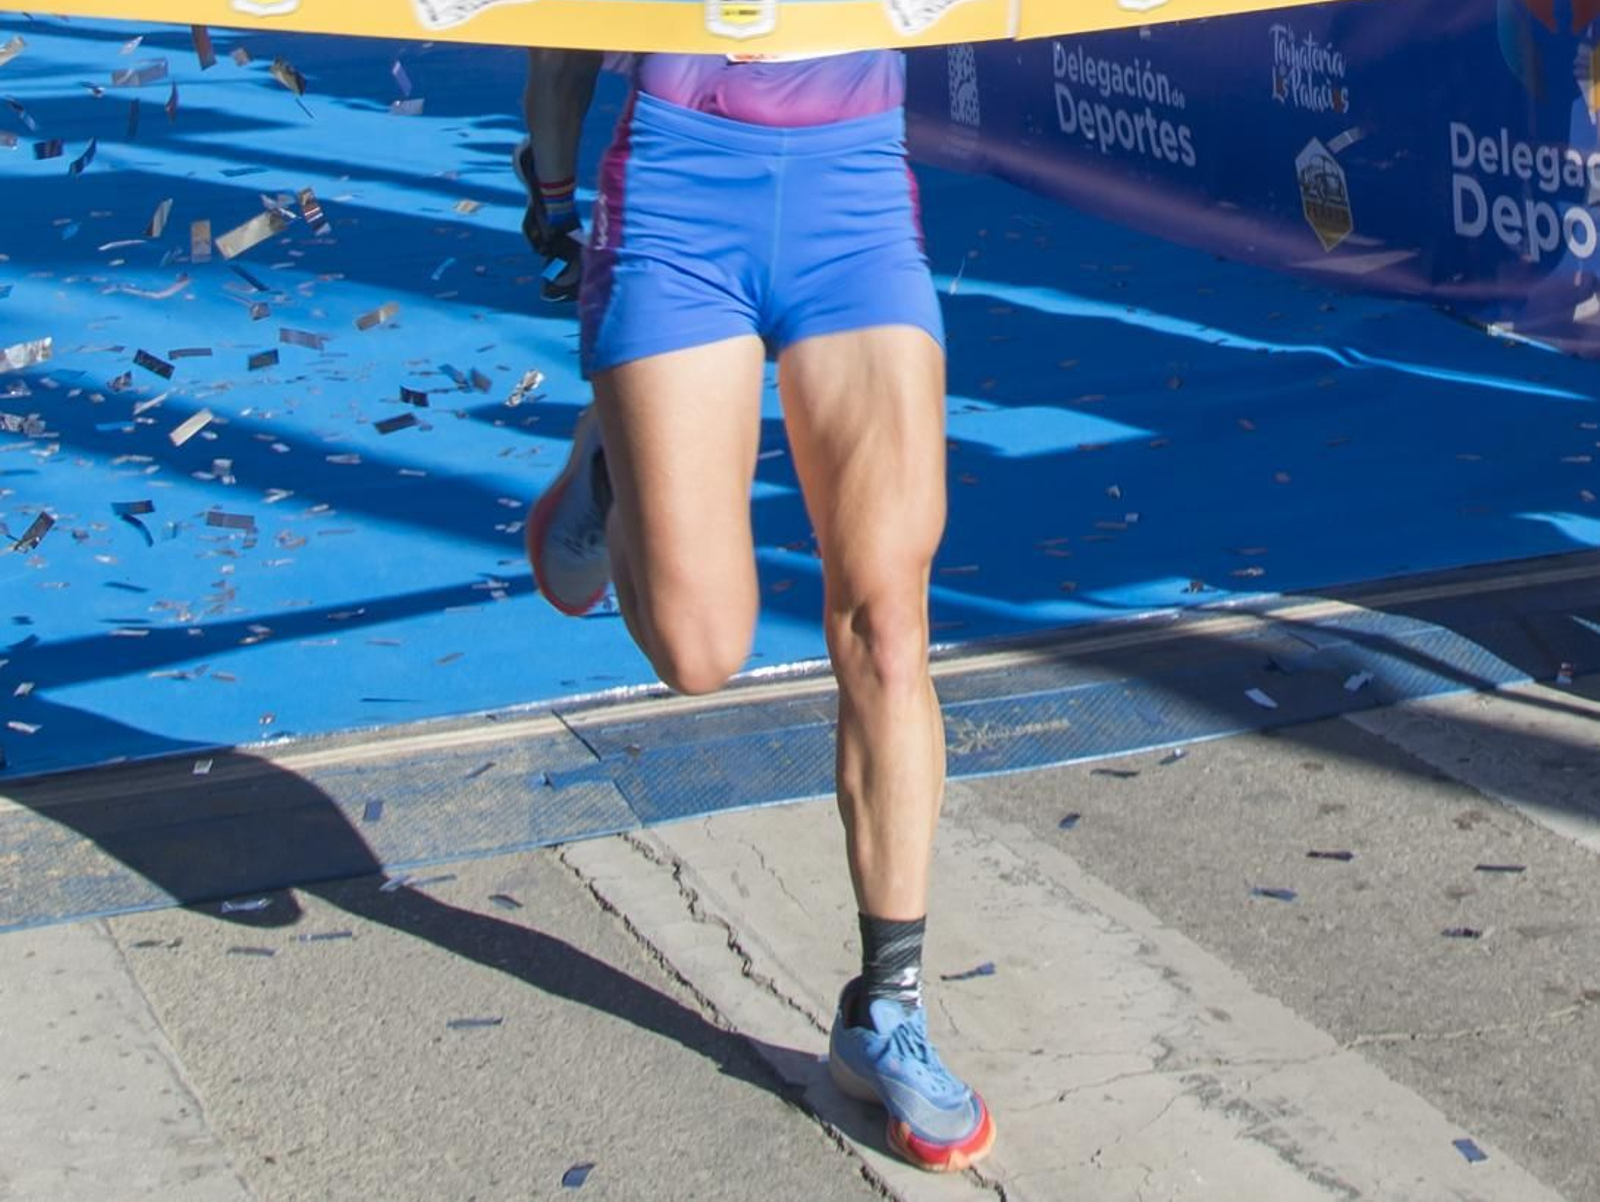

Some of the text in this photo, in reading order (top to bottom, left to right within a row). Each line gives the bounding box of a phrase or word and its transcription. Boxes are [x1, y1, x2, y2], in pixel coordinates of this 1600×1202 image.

[1053, 41, 1170, 108] Delegación
[1054, 81, 1197, 168] Deportes
[1452, 173, 1598, 264] Depo
